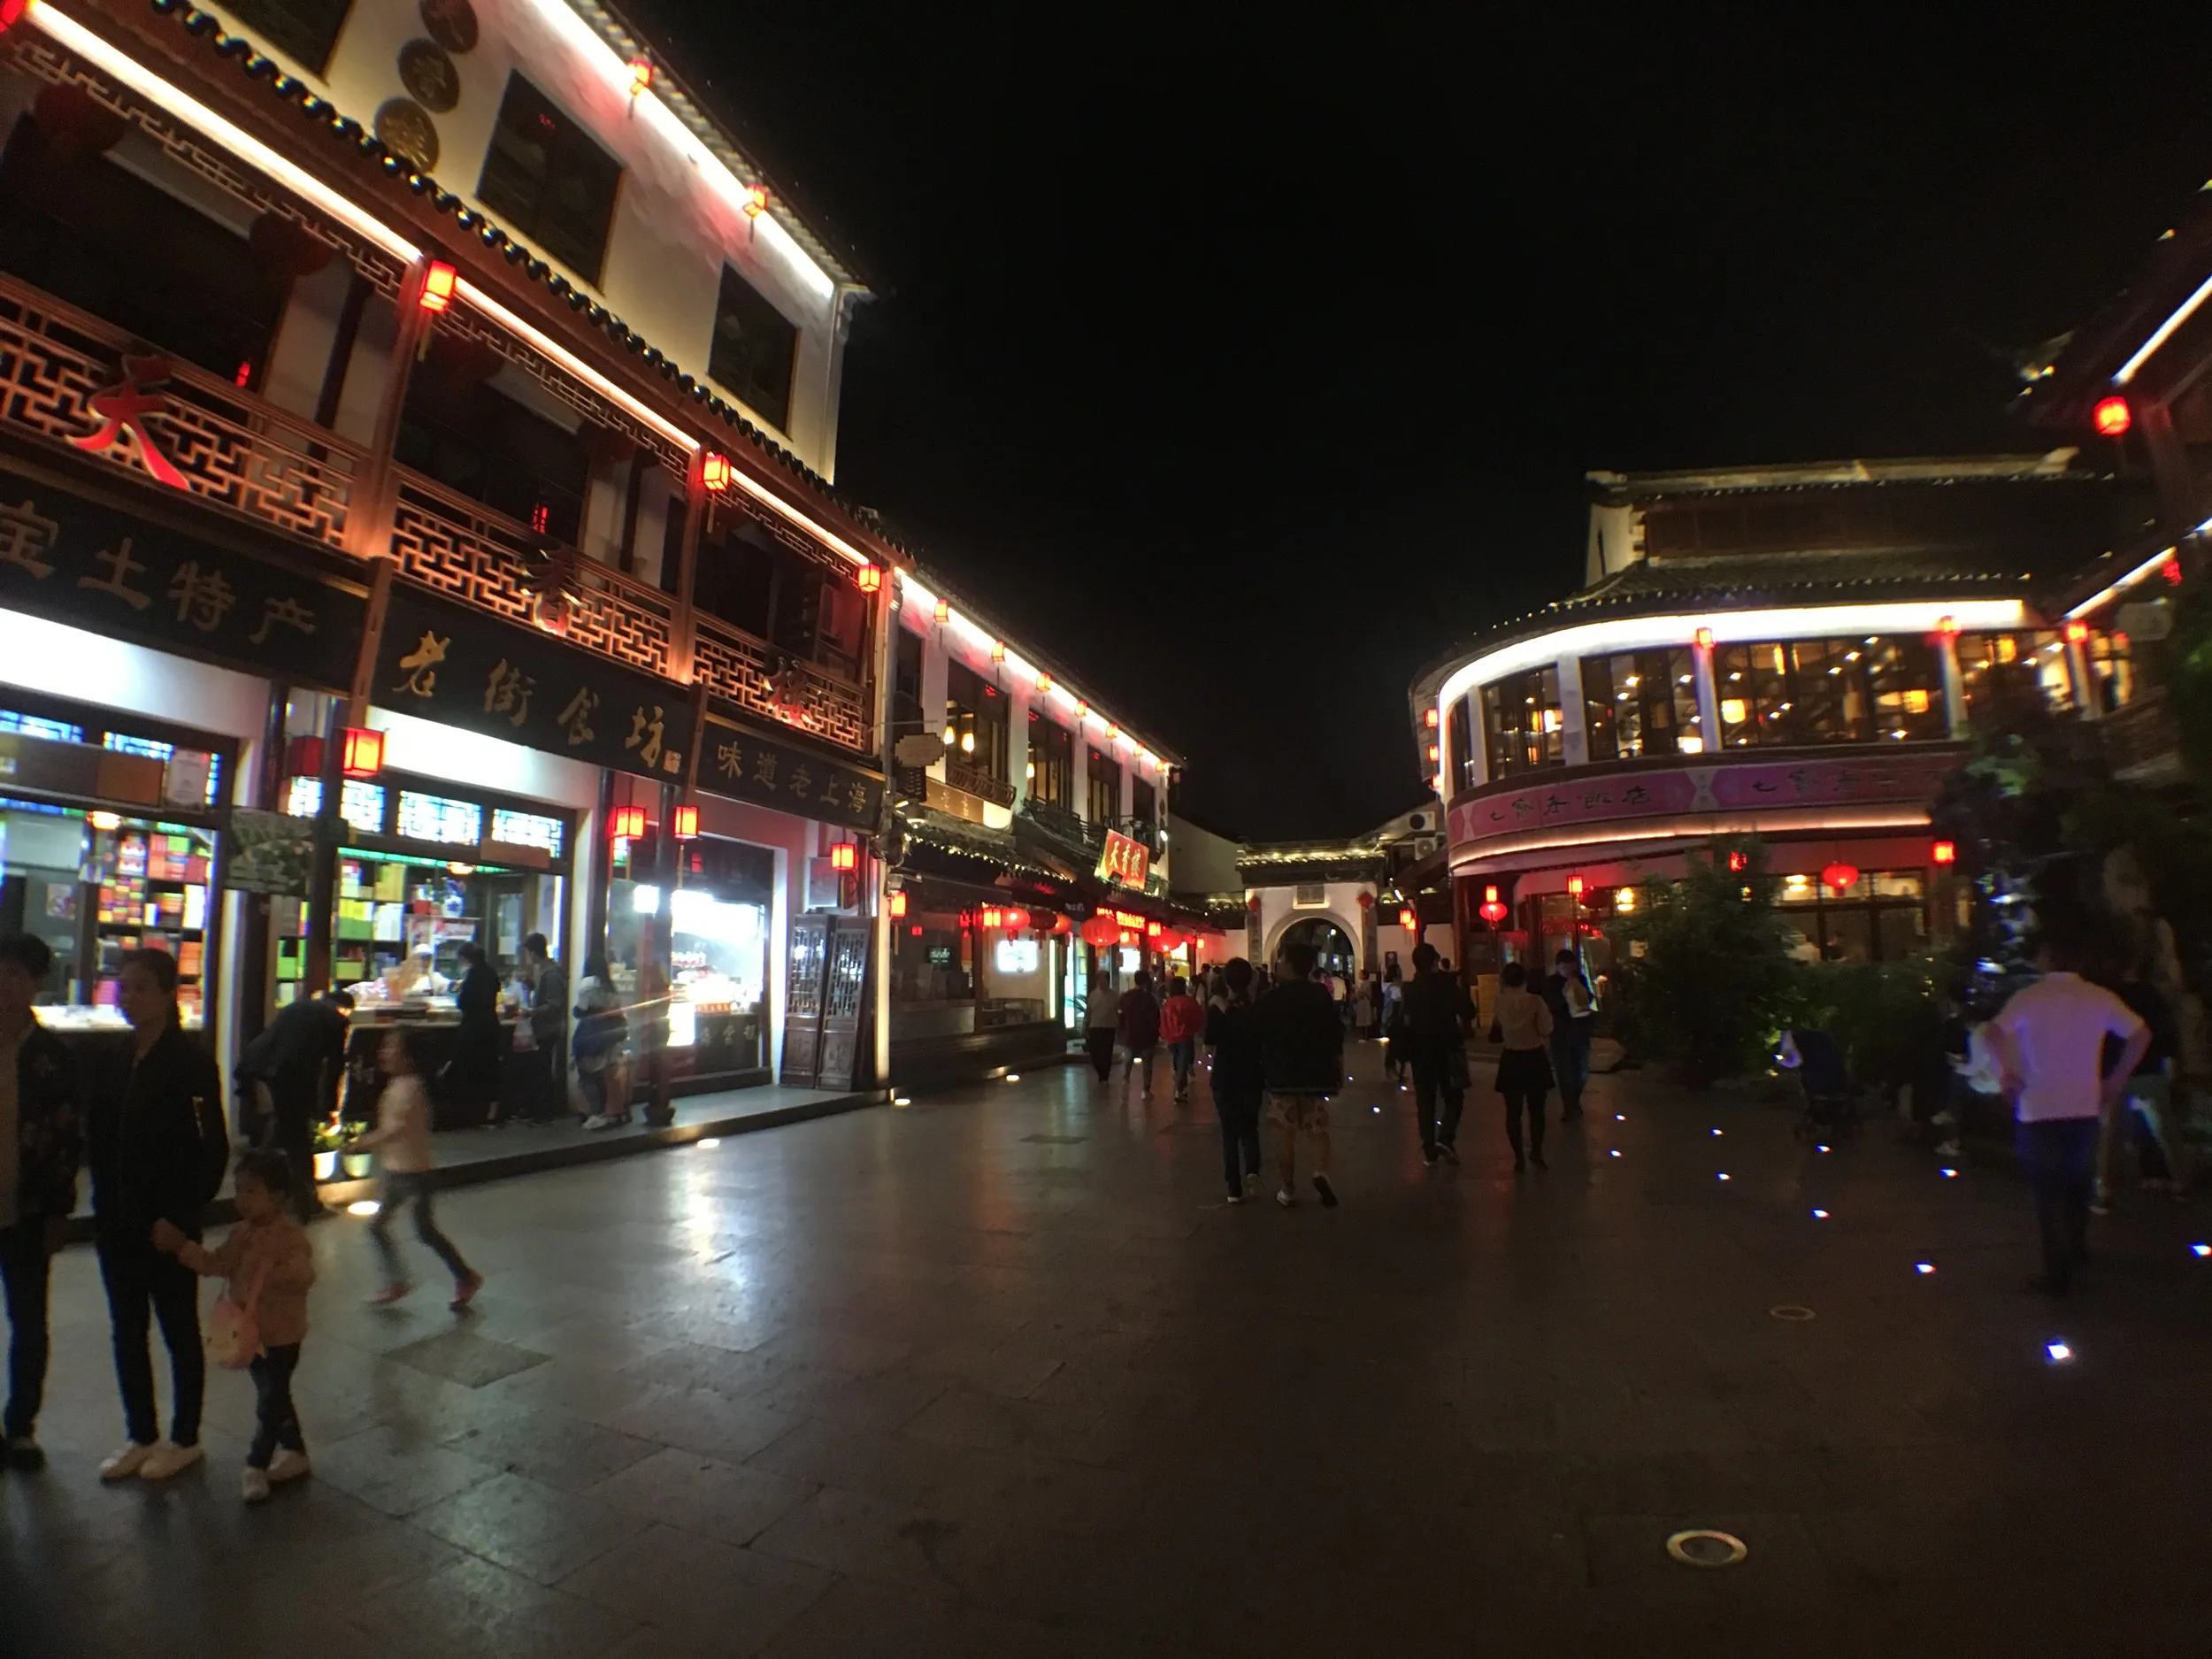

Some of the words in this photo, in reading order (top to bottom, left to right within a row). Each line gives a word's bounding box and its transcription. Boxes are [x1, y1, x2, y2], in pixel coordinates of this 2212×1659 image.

[717, 741, 868, 813] 味道老上海
